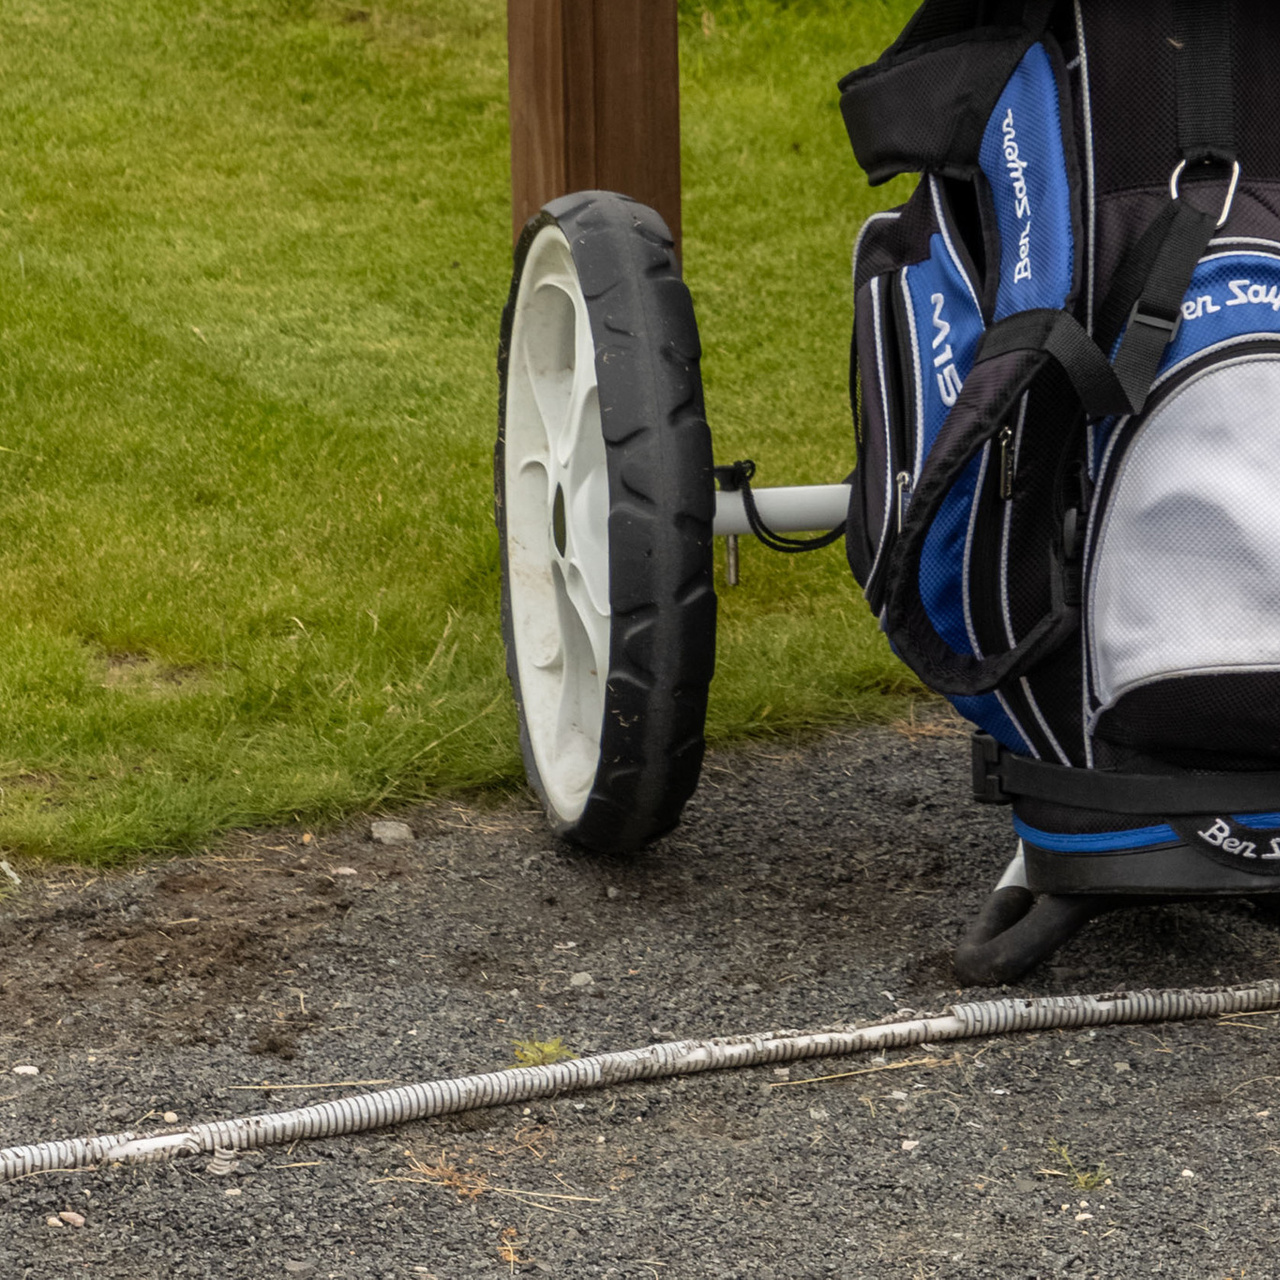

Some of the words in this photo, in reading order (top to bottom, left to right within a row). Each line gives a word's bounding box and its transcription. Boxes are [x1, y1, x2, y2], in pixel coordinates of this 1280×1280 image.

[999, 108, 1032, 219] Sayers
[1012, 221, 1032, 285] Ben
[1181, 295, 1221, 321] en
[1197, 818, 1257, 858] Ben
